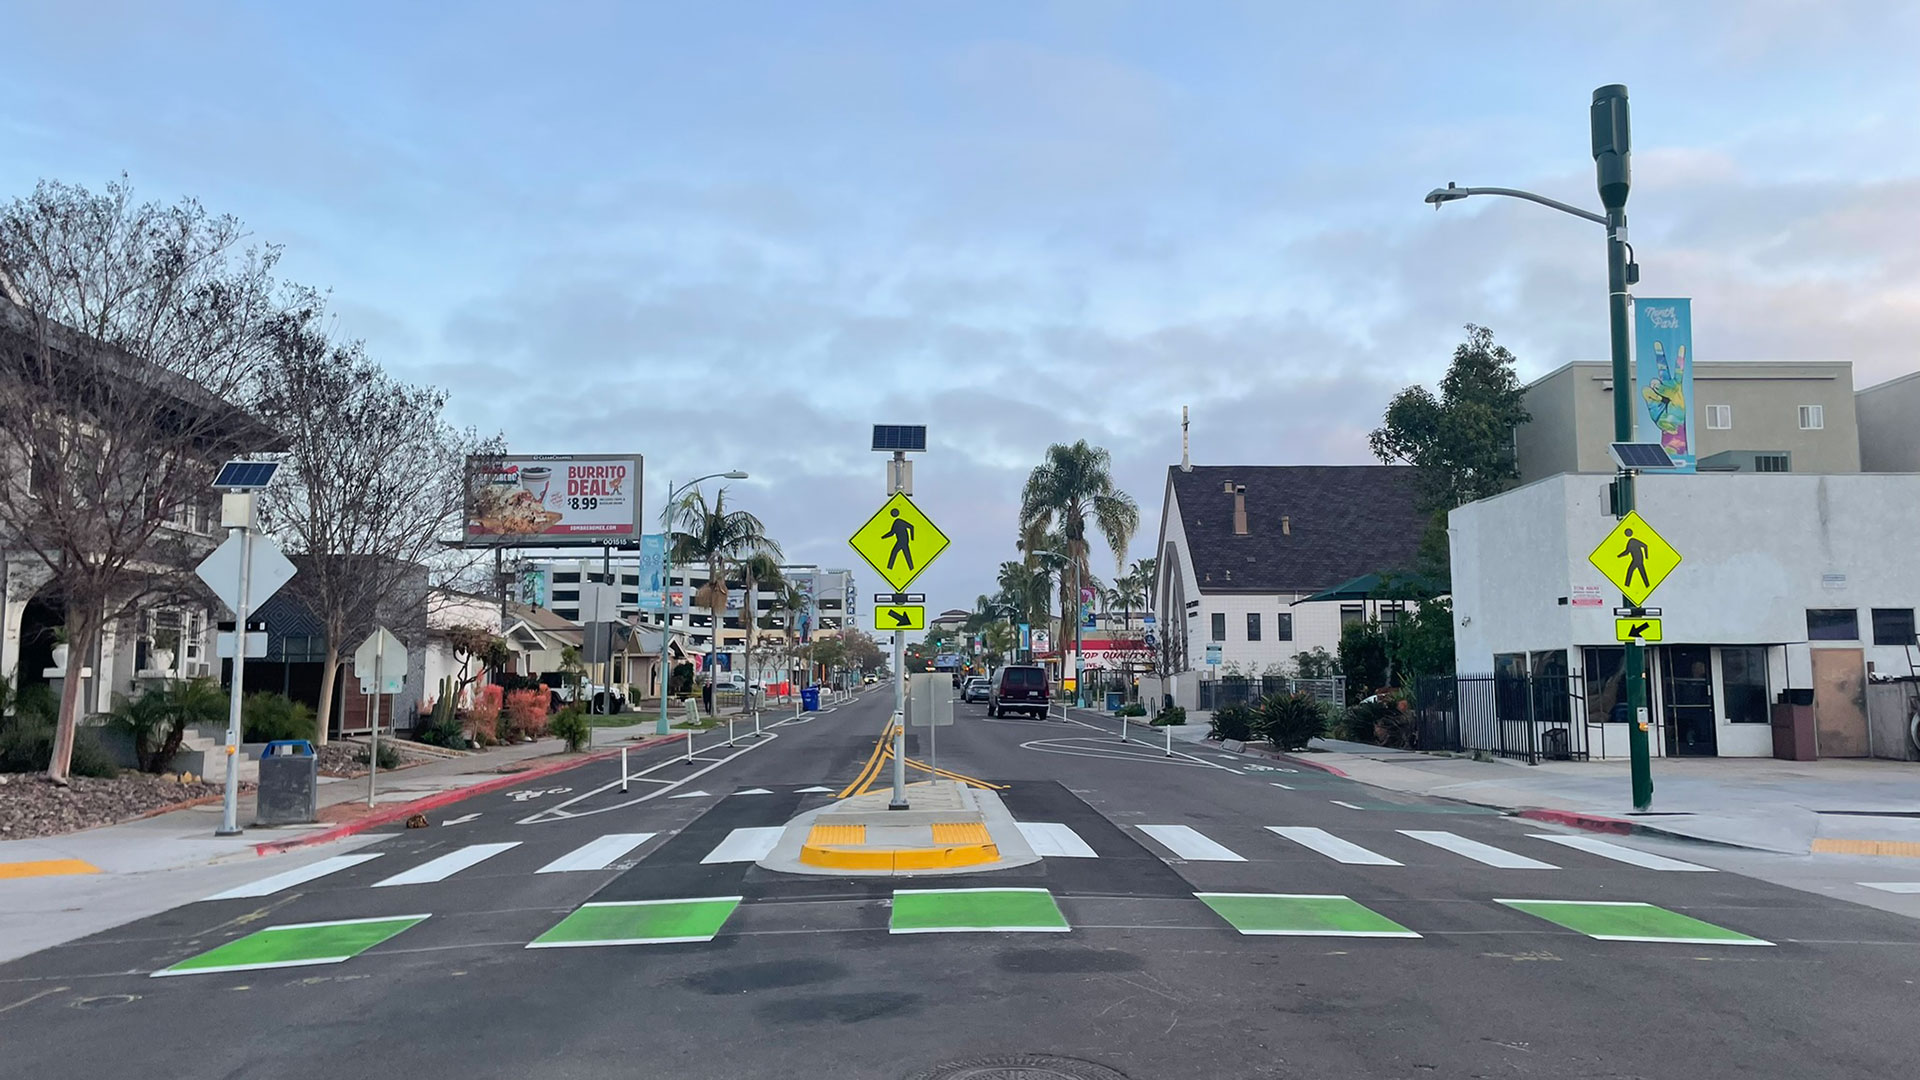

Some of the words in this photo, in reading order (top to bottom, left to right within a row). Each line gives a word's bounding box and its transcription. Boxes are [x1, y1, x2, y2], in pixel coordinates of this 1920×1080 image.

[568, 465, 626, 479] BURRITO
[567, 479, 610, 496] DEAL
[567, 497, 598, 510] $8.99
